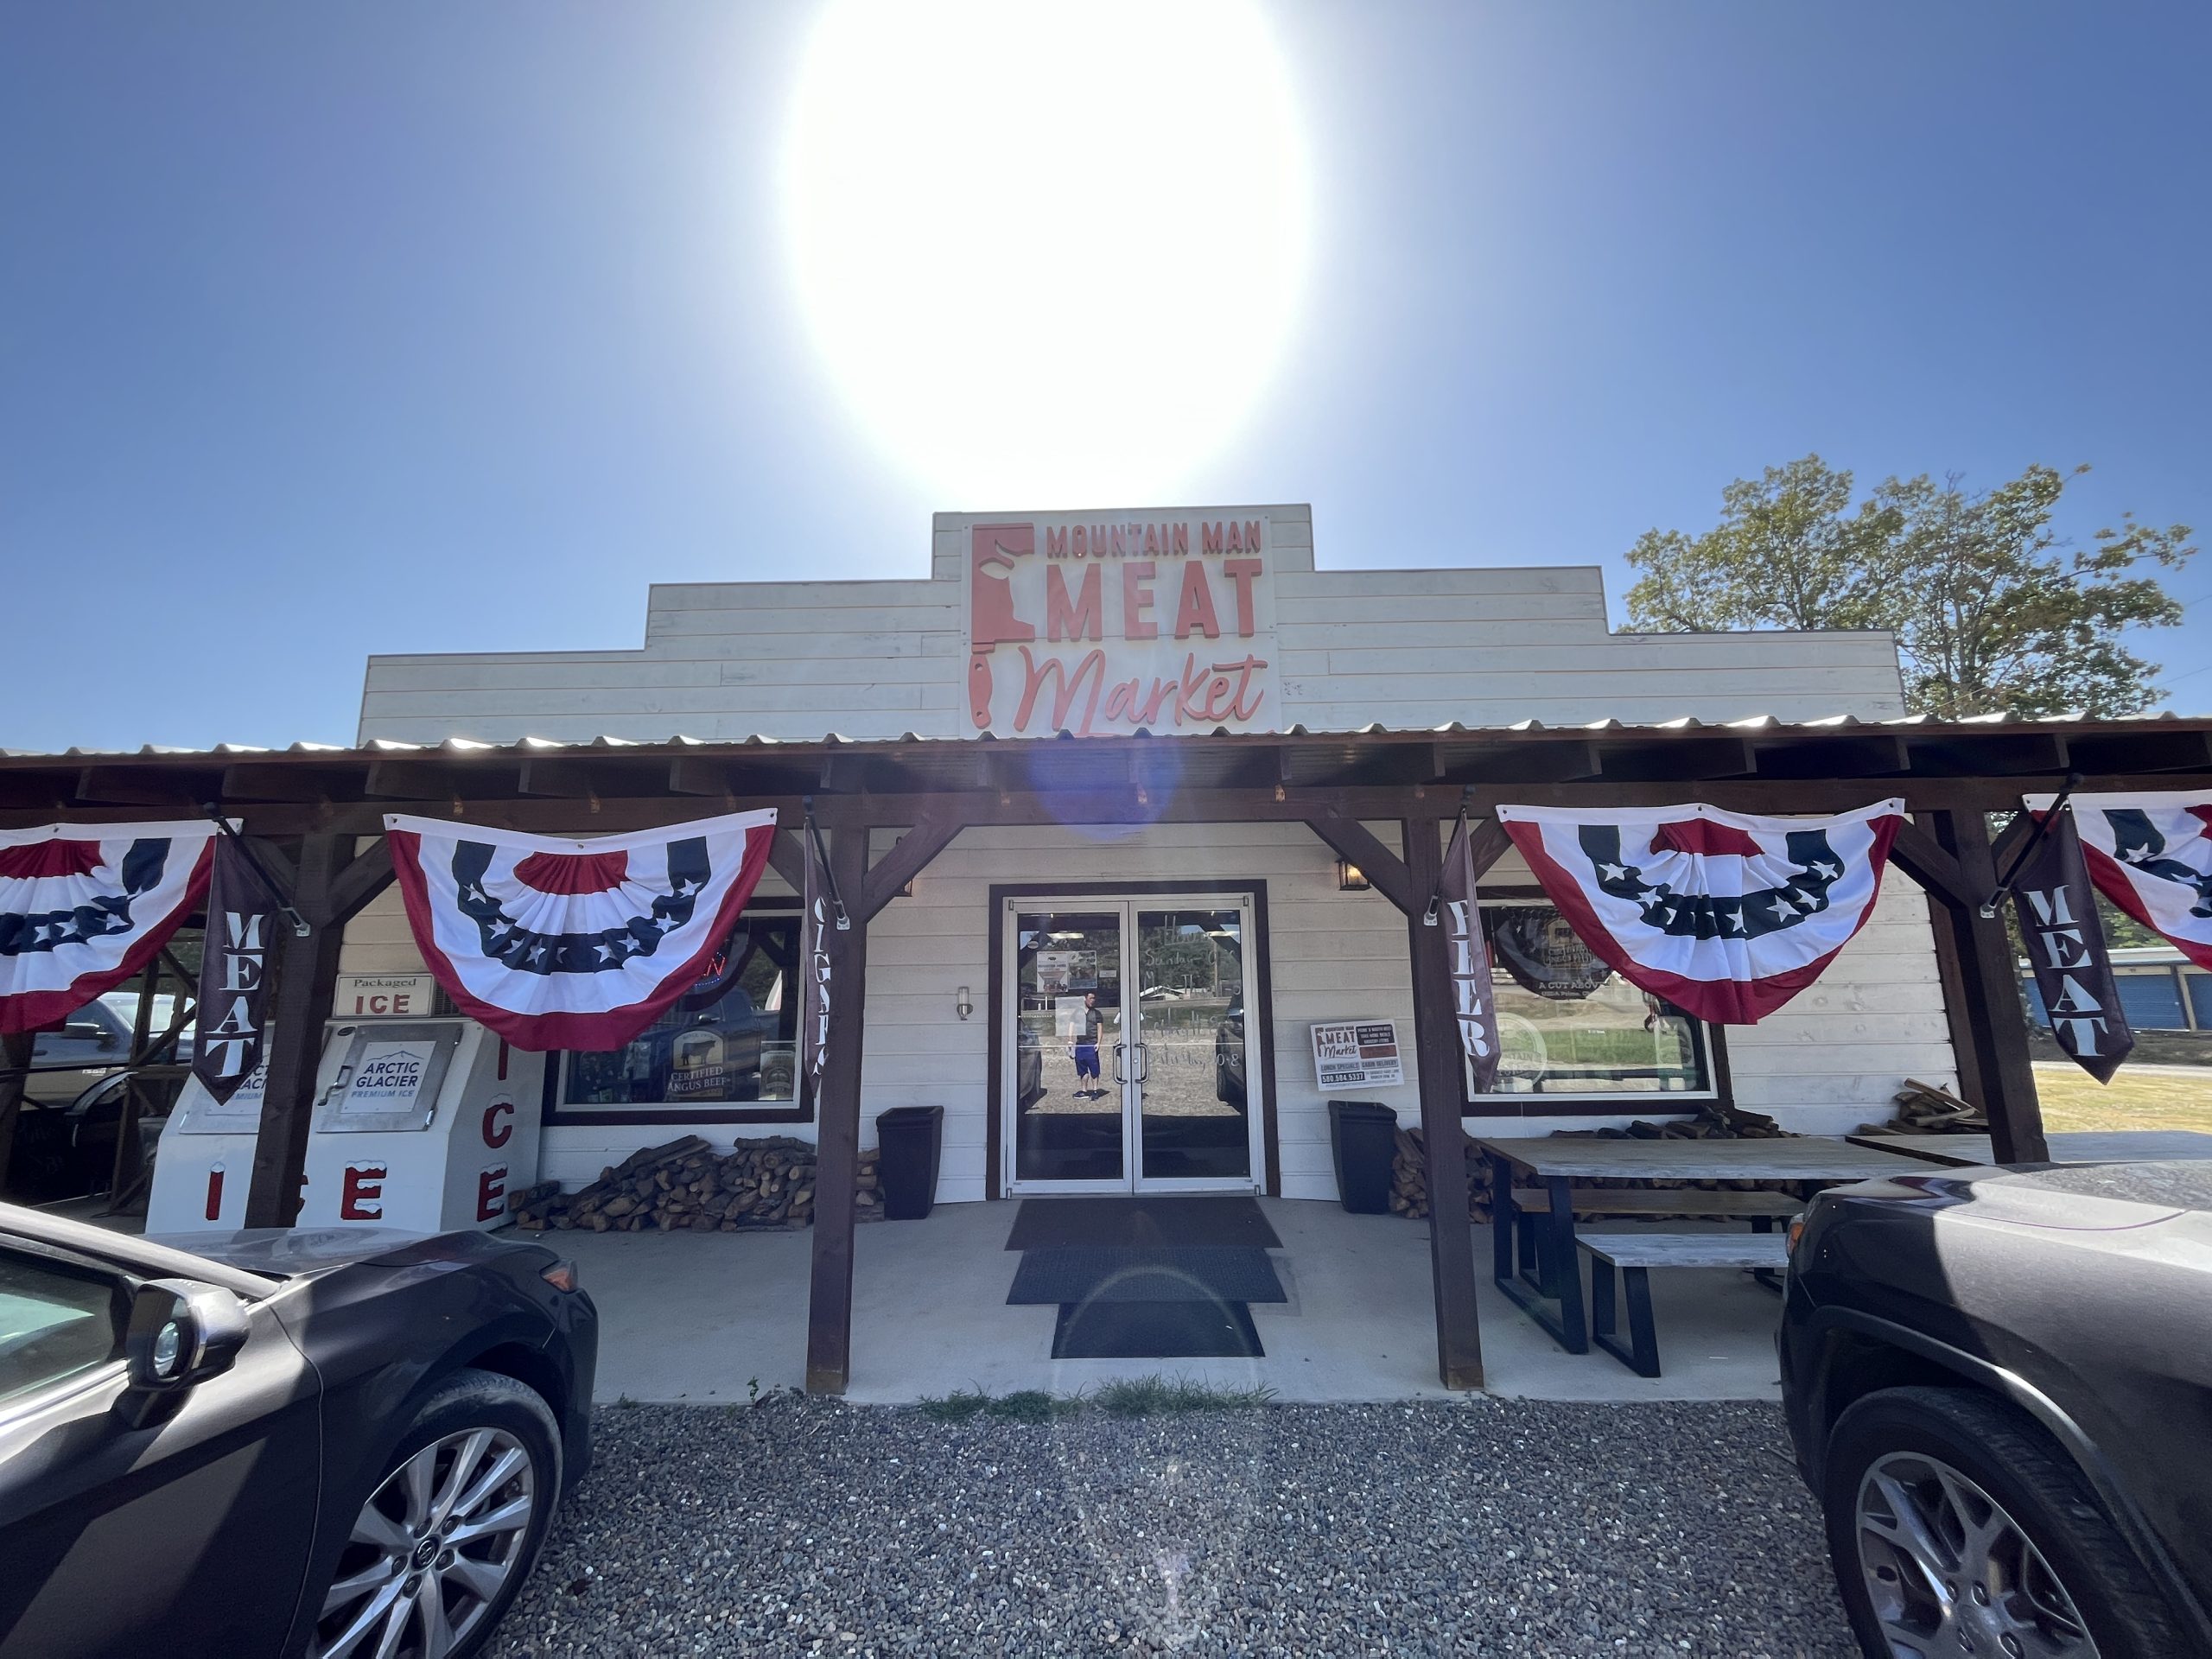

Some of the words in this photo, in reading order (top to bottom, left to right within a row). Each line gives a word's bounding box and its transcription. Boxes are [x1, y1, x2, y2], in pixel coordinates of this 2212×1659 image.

[1046, 522, 1188, 559] MOUNTAIN
[1201, 520, 1262, 555] MAN
[1046, 558, 1262, 643] MEAT
[1013, 645, 1269, 736] Market
[2023, 885, 2109, 1058] MEAT
[354, 978, 416, 988] Packaged
[1571, 981, 1605, 989] ABOV
[204, 912, 265, 1078] MEAT
[354, 994, 410, 1014] ICE
[1326, 1032, 1356, 1045] MEAT
[1324, 1045, 1357, 1058] Market
[364, 1062, 420, 1074] ARCTIC
[671, 1066, 723, 1082] CERTIFIED
[356, 1076, 418, 1088] GLACIER
[667, 1078, 702, 1092] ANGUS
[704, 1077, 727, 1088] BEEF
[204, 1160, 388, 1221] IE
